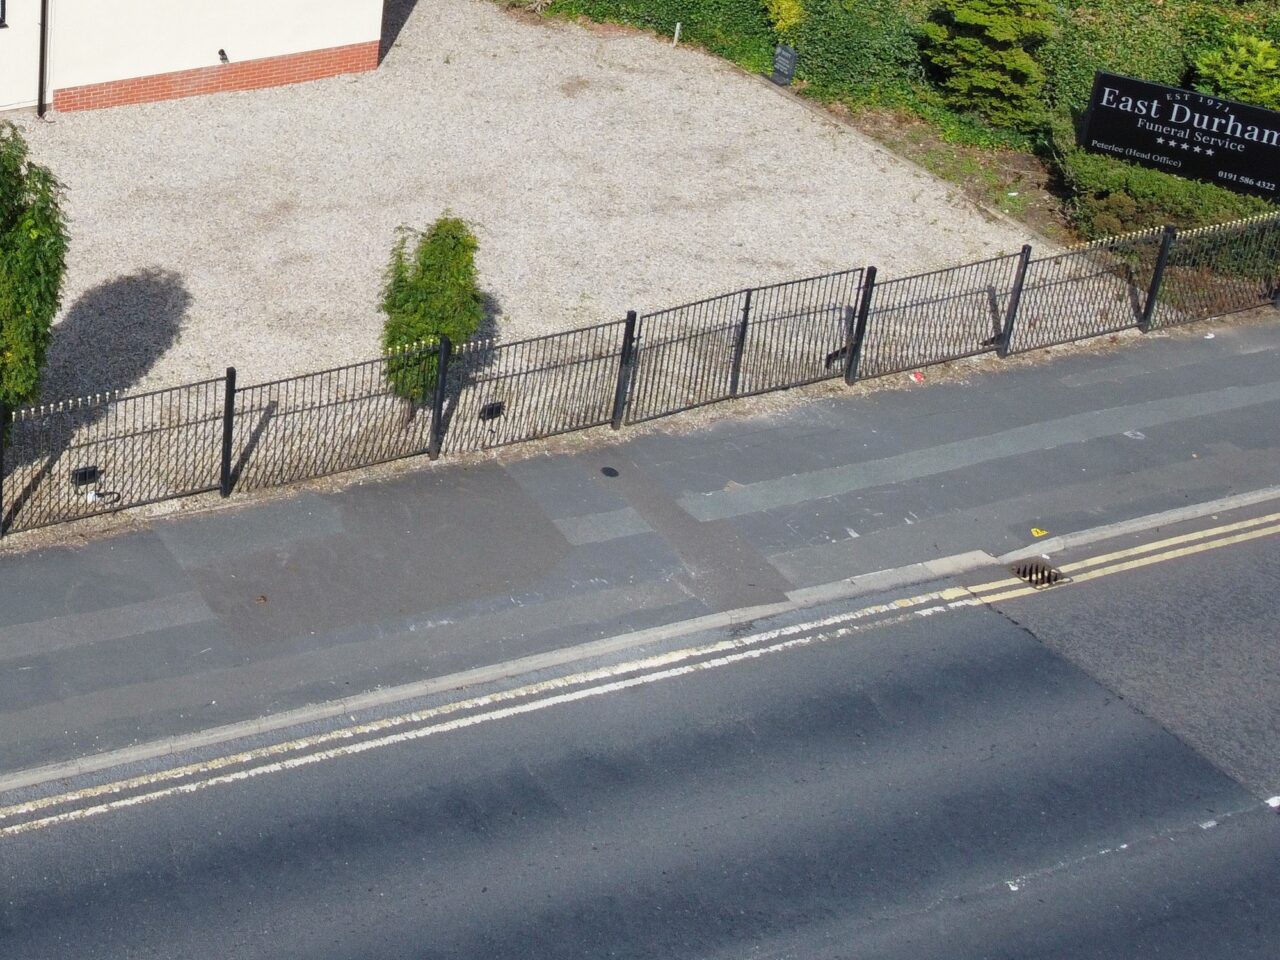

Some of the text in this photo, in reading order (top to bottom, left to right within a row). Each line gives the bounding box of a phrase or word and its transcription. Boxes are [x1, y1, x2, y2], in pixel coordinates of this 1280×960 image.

[1100, 87, 1161, 118] East
[1166, 93, 1229, 112] EST 1971
[1137, 118, 1245, 152] Funeral Service
[1091, 140, 1182, 168] Peterlee (Head Office)
[1218, 170, 1276, 191] 0191 586 4322
